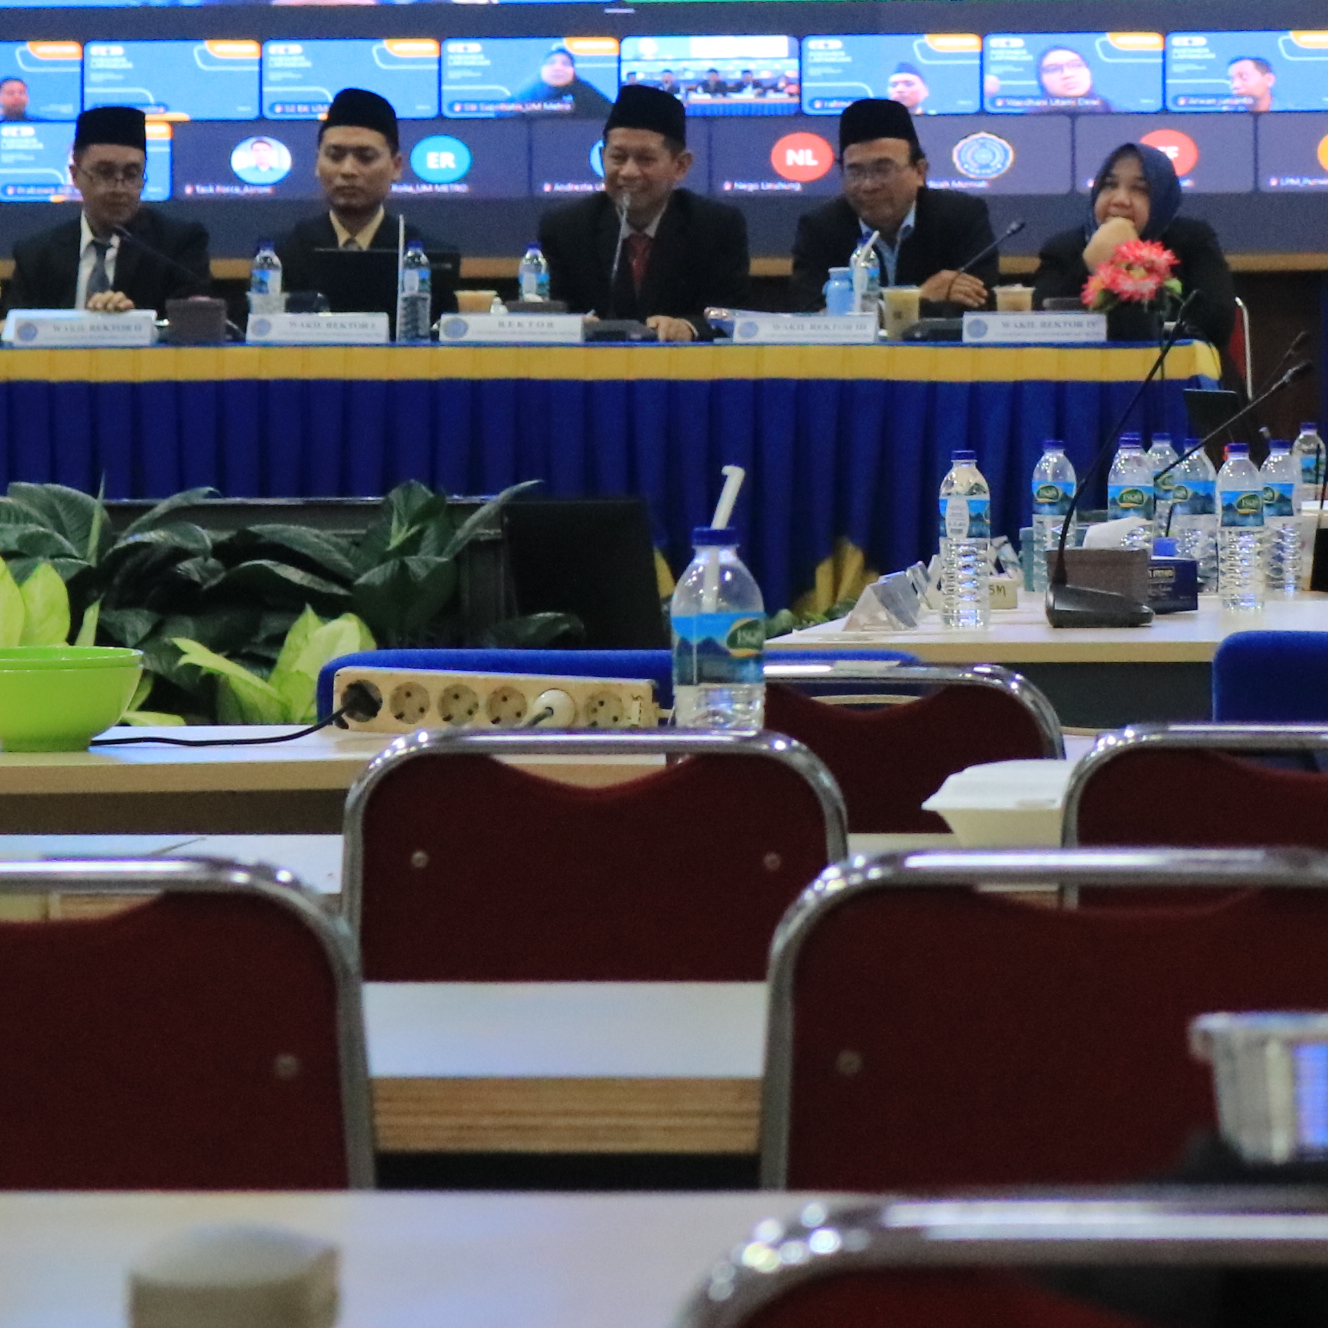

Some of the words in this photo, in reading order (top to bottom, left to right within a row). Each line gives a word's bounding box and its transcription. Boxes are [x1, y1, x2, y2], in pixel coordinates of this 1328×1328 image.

[427, 151, 456, 170] ER
[786, 148, 819, 167] NL
[497, 320, 554, 329] REKTOR
